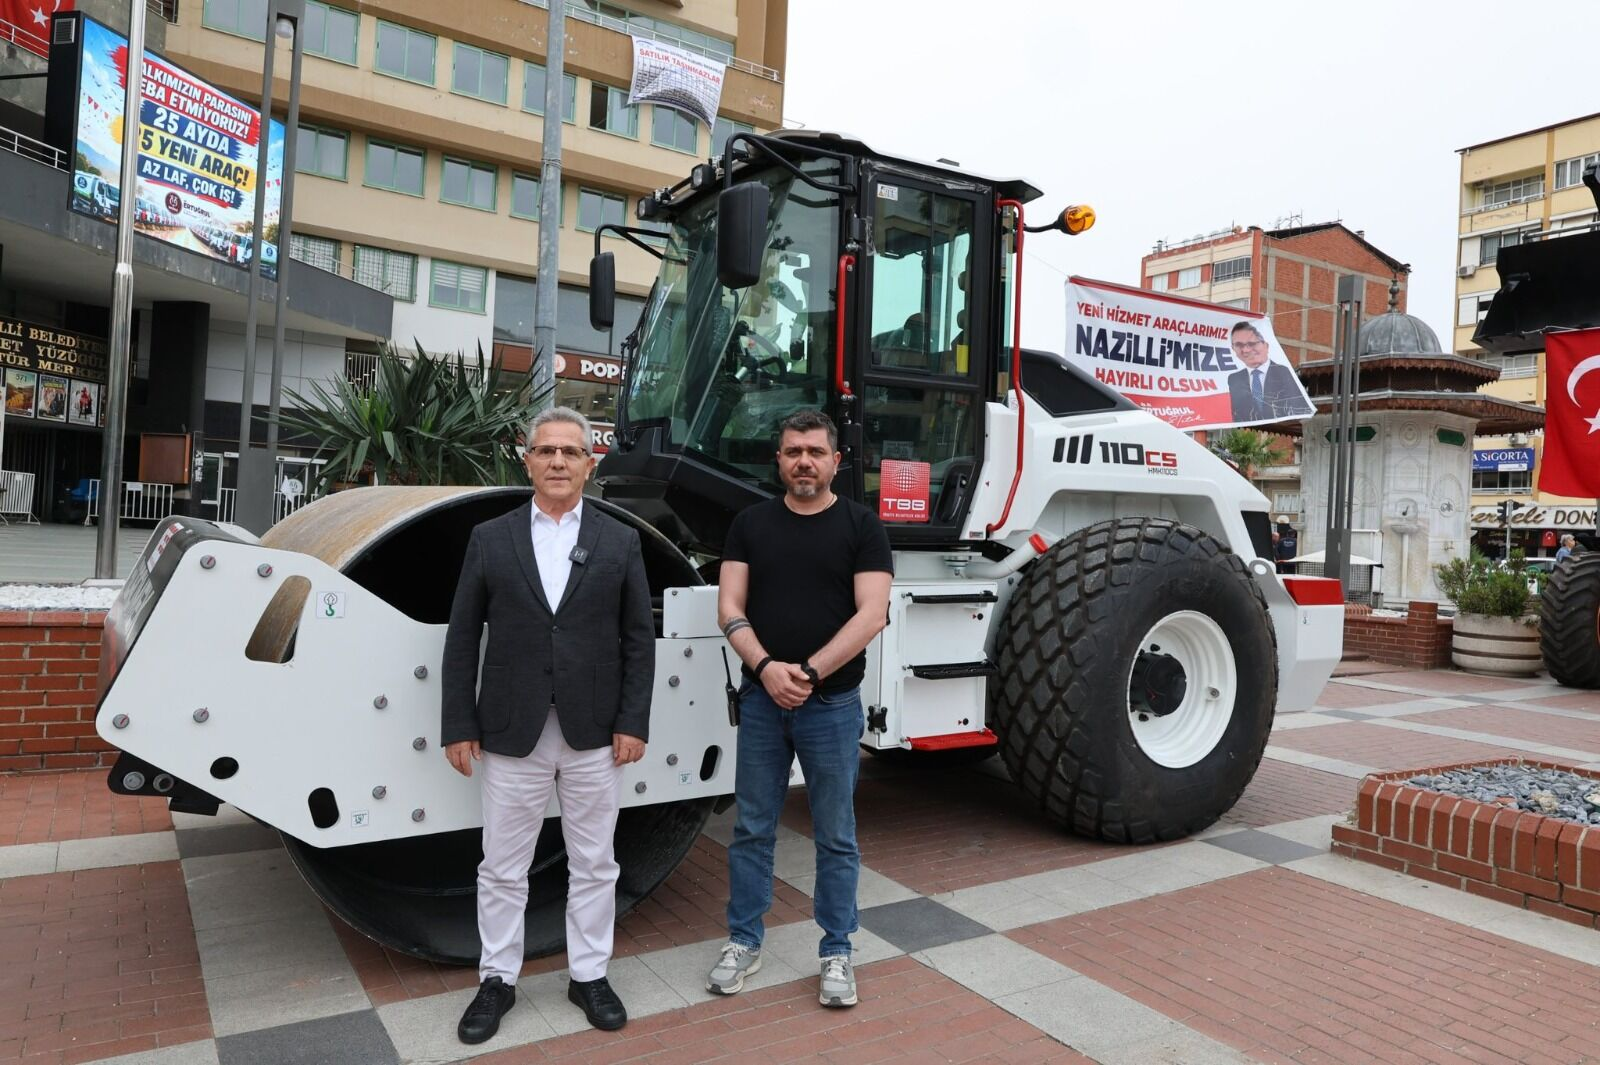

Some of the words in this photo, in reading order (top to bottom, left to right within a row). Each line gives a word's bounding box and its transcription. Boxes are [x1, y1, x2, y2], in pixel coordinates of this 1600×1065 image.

[202, 92, 252, 125] PARASINI
[153, 107, 180, 134] 25
[183, 121, 230, 155] AYDA
[139, 128, 154, 151] 5
[200, 154, 249, 189] ARAÇ!
[142, 159, 160, 178] AZ
[163, 166, 189, 190] LAF,
[192, 177, 218, 198] ÇOK
[1076, 301, 1104, 319] YENİ
[1106, 305, 1152, 327] HİZMET
[1153, 315, 1230, 340] ARAÇLARIMIZ
[1095, 367, 1154, 390] HAYIRLI
[1157, 375, 1218, 393] OLSUN
